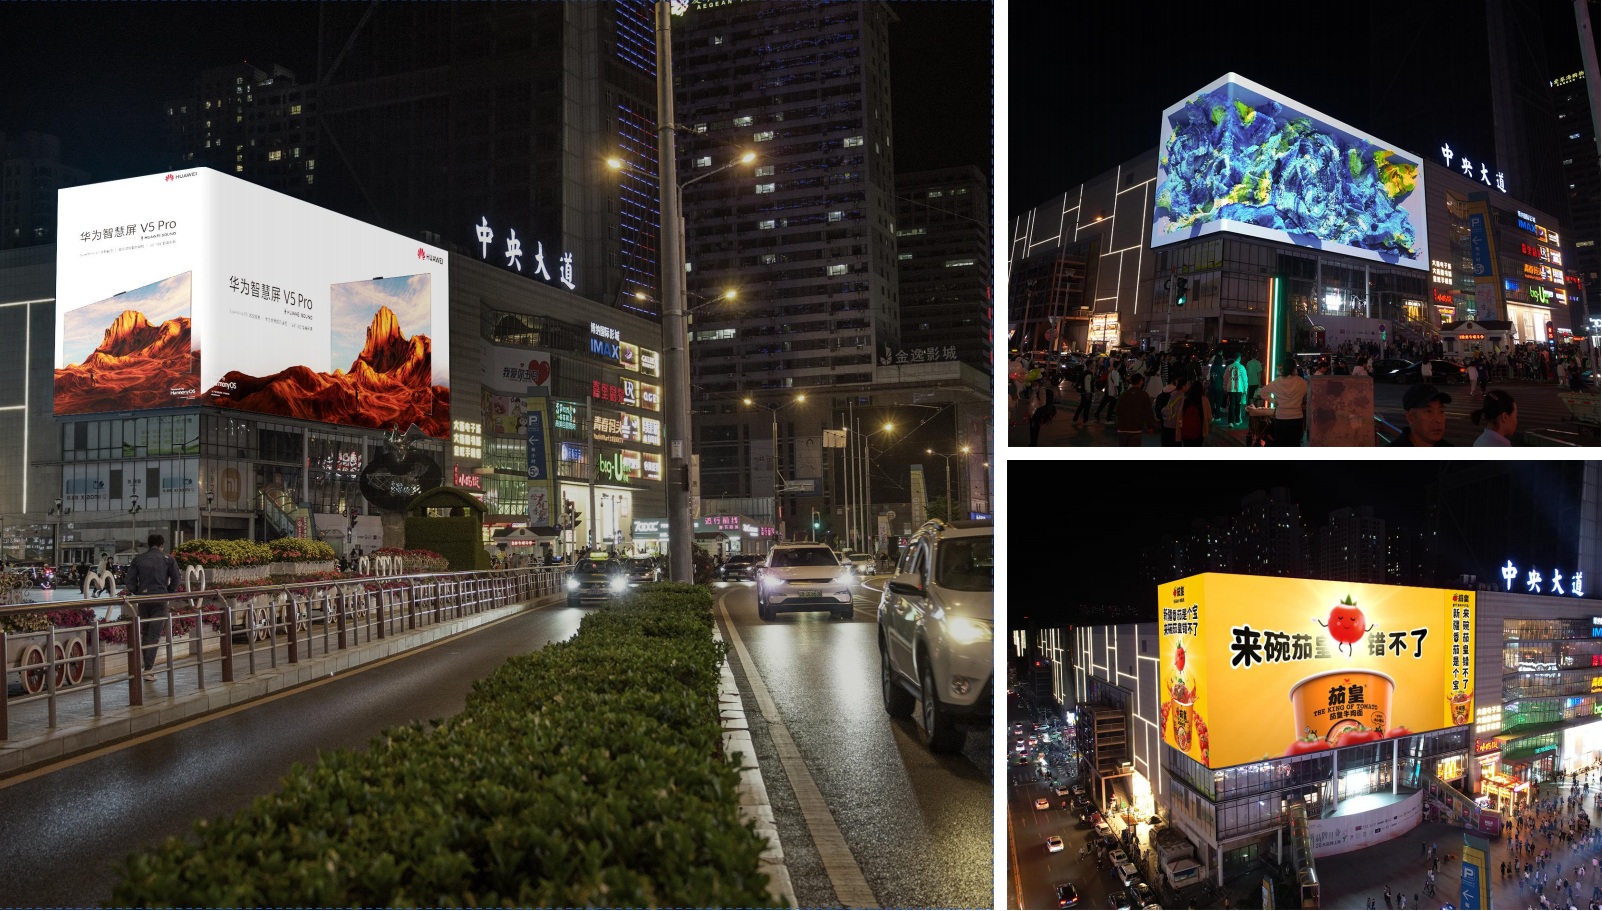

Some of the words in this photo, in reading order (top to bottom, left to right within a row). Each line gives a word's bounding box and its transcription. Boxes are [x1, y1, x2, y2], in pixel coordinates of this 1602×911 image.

[697, 0, 732, 10] AEGEAN
[175, 171, 198, 179] HUAWEI
[1441, 143, 1507, 193] 中央大道
[80, 224, 137, 242] 华为智慧屏
[140, 221, 155, 233] V5
[158, 220, 177, 231] Pro
[1518, 219, 1536, 233] IMAX
[475, 216, 576, 290] 中央大道
[229, 275, 281, 303] 华为智慧屏
[283, 289, 296, 306] V5
[298, 293, 313, 310] Pro
[590, 338, 619, 359] IMAX
[895, 345, 957, 363] 金逸影城
[528, 415, 538, 426] P
[1501, 560, 1584, 597] 中央大道
[1164, 622, 1198, 637] 来碗茄皇错不了
[1452, 608, 1460, 691] 新疆番茄是个宝
[1462, 608, 1470, 690] 来碗茄皇错不了
[1328, 684, 1364, 706] 茄皇
[1313, 708, 1326, 717] THE
[1327, 704, 1345, 713] KING
[1329, 709, 1363, 720] 茄皇牛肉面
[1463, 867, 1474, 878] P
